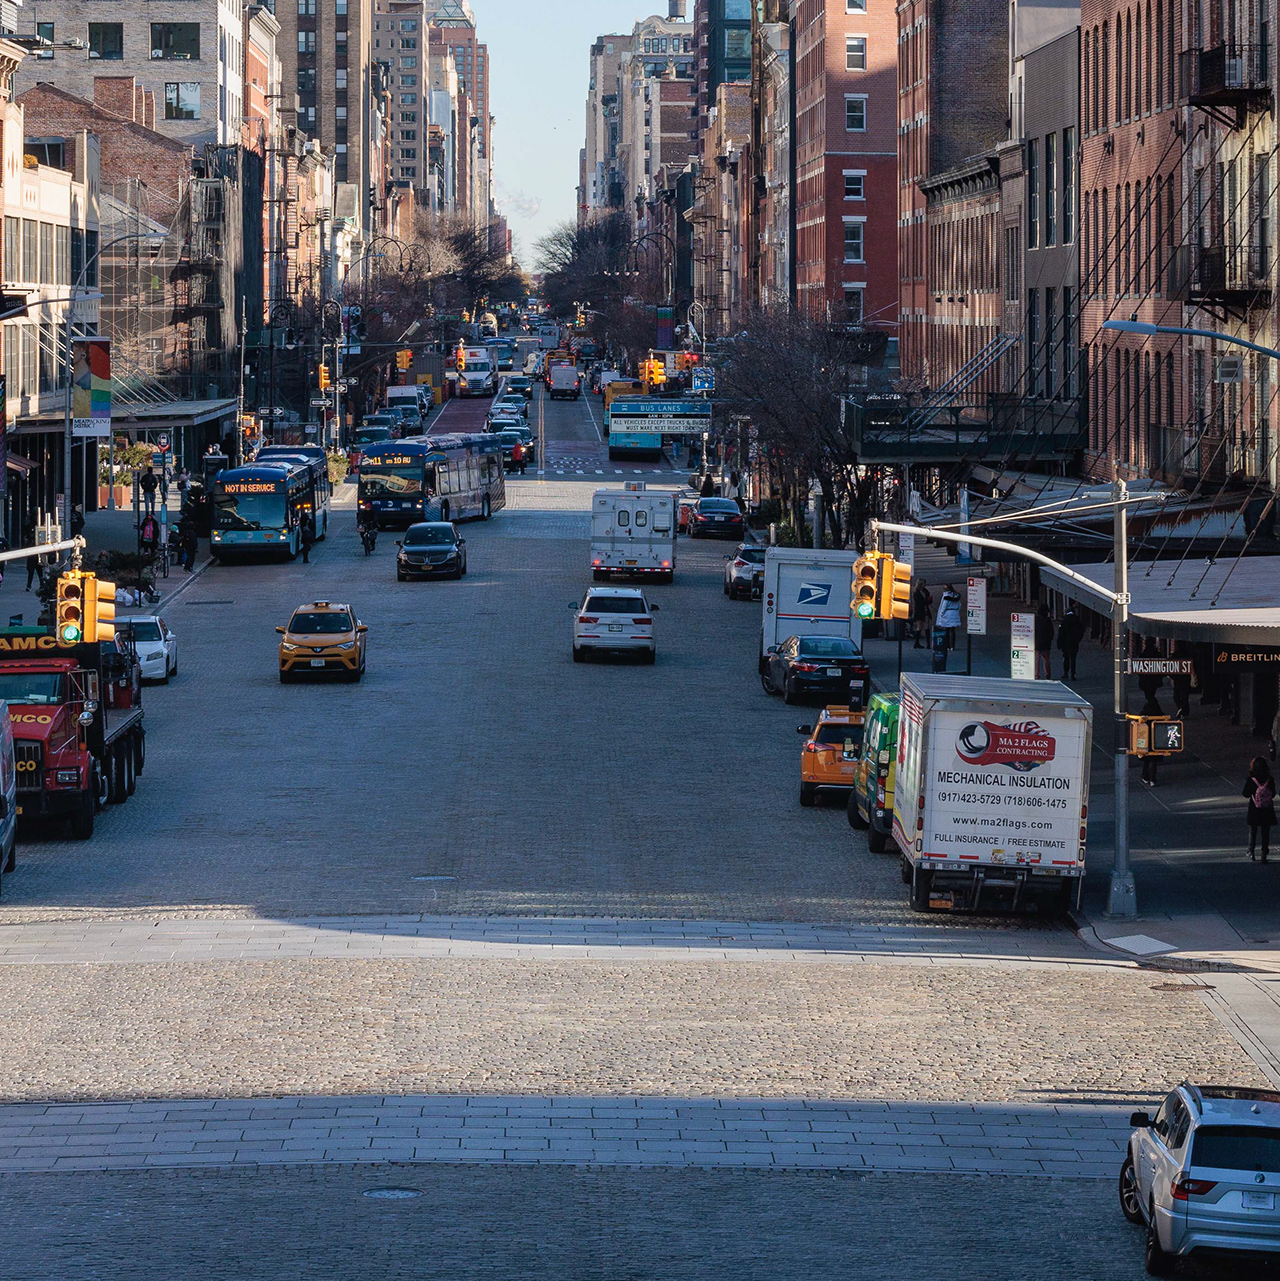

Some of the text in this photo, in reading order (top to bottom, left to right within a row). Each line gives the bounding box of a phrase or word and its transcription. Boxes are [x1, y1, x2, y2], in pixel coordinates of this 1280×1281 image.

[225, 484, 275, 492] NOT IN SERVICE
[1133, 660, 1191, 673] WASHINGTON ST
[999, 738, 1048, 748] MA 2 FLAGS
[997, 747, 1048, 756] CONTRACTING
[938, 771, 1070, 790] MECHANICAL INSULATION
[938, 792, 1067, 809] (917)423-5729 (718)606-1475
[953, 817, 1052, 829] www.ma2flags.com
[934, 834, 952, 842] FULL
[955, 835, 999, 845] INSURANCE
[1008, 838, 1027, 847] FREE
[1029, 839, 1065, 848] ESTIMATE
